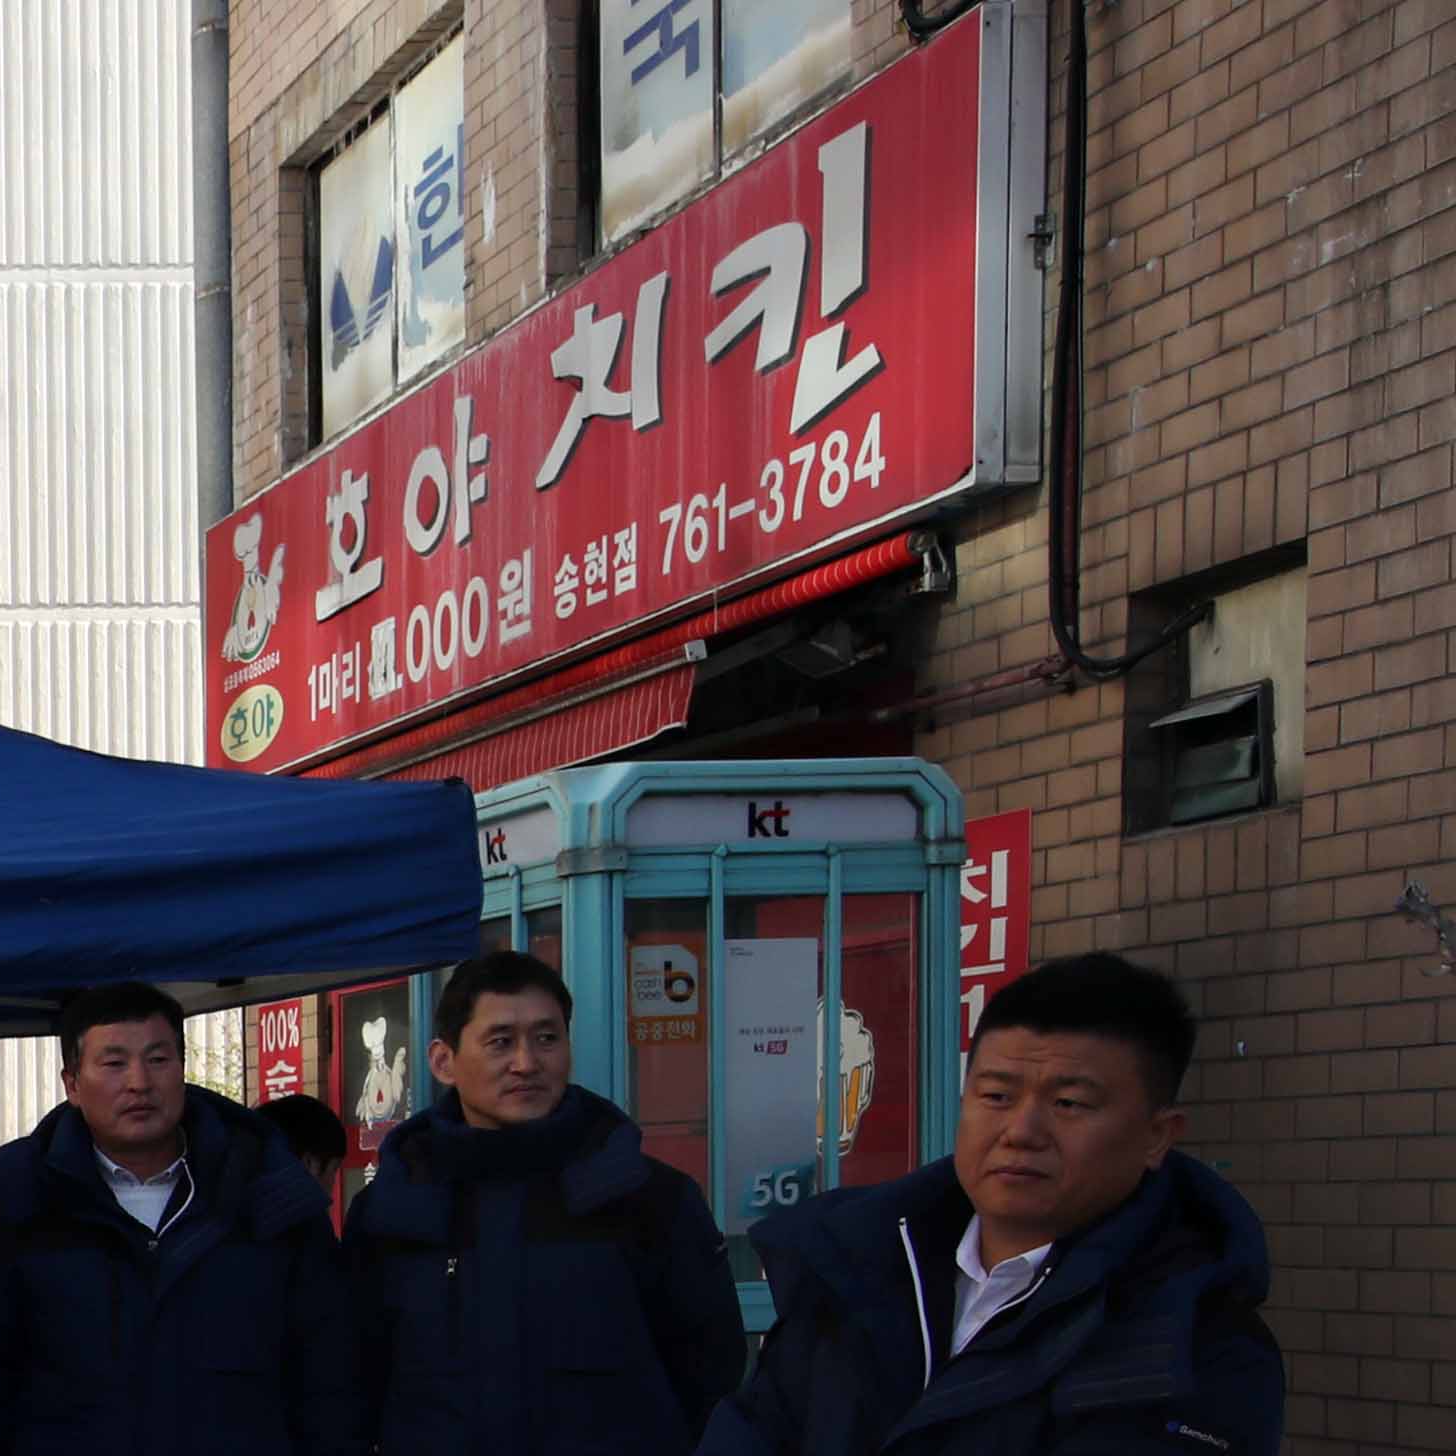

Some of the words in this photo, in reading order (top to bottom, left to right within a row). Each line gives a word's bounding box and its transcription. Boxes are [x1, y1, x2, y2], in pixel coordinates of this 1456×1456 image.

[307, 641, 361, 722] 1마리
[553, 522, 640, 621] 송현점
[658, 413, 887, 578] 761-3784
[229, 693, 275, 751] 호야
[747, 801, 791, 838] kt
[486, 828, 507, 866] kt
[260, 1006, 300, 1054] 100%
[750, 1169, 801, 1207] 5G
